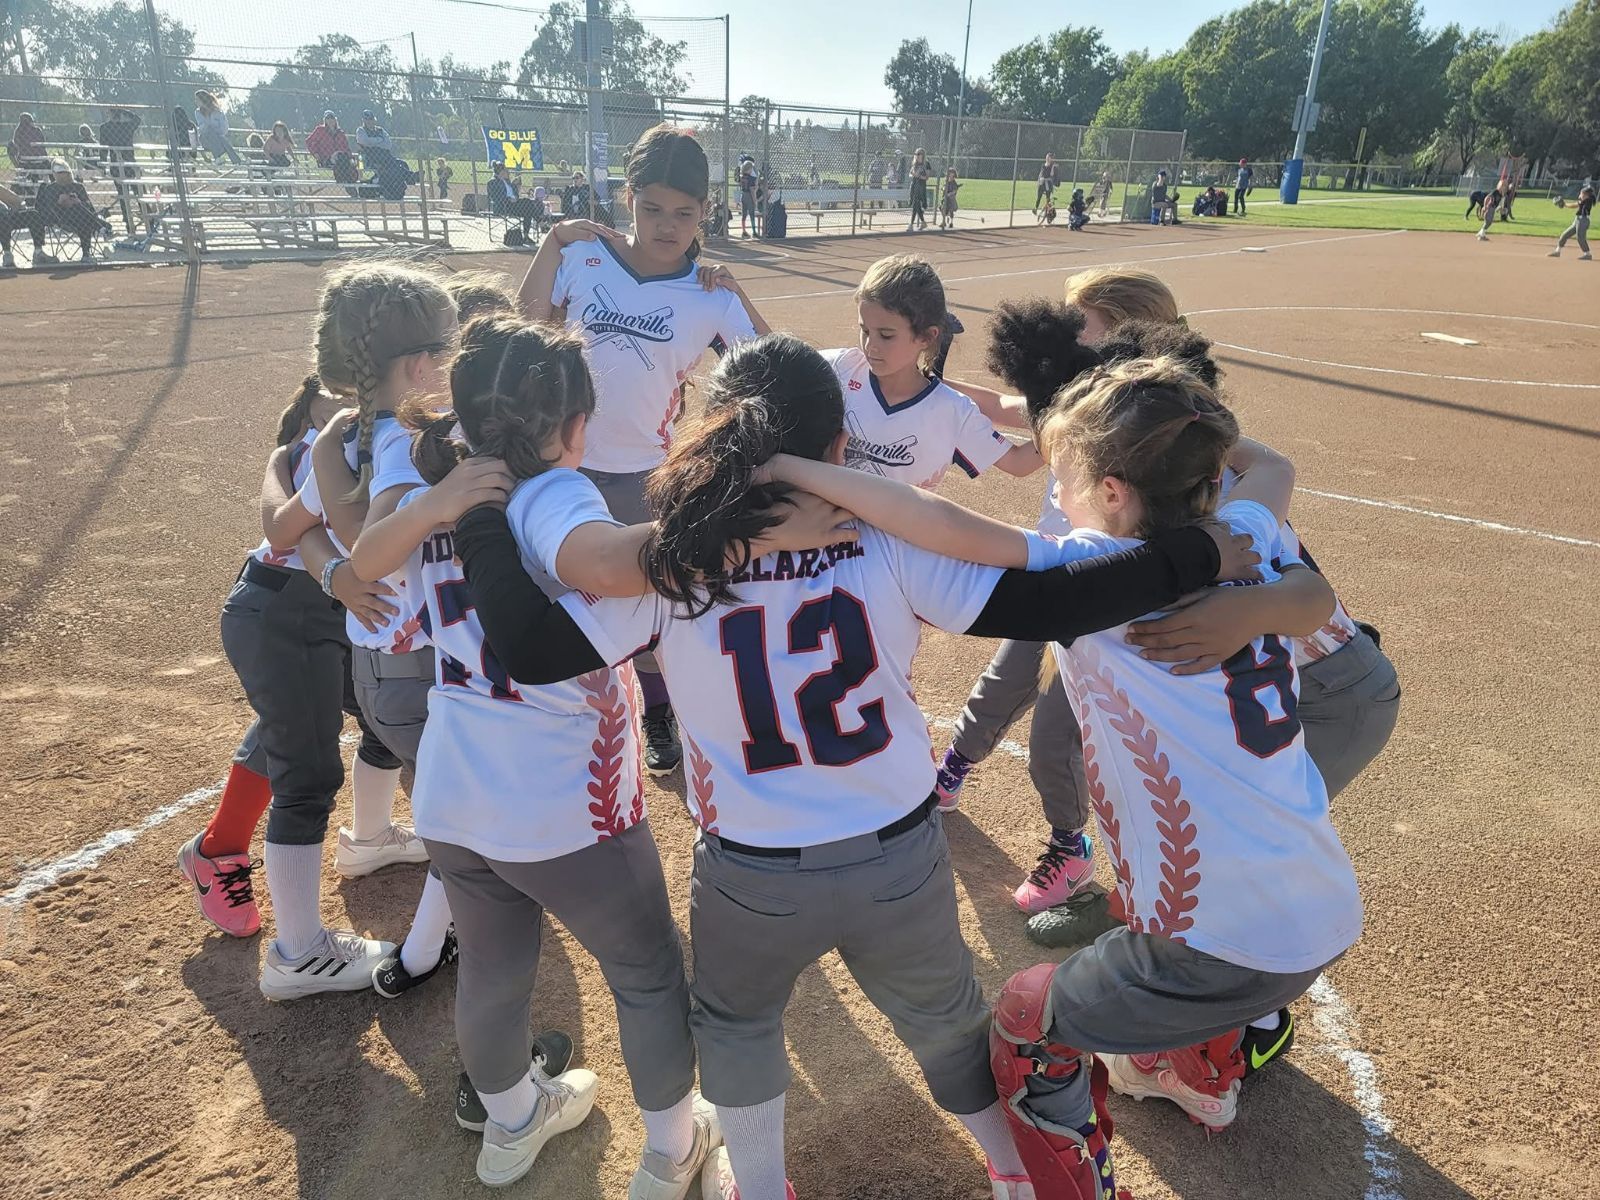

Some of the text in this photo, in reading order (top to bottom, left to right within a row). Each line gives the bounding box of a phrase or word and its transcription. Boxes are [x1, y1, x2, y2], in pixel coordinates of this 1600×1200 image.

[488, 129, 537, 141] GO BLUE
[502, 141, 534, 169] M
[582, 303, 673, 338] Camarillo
[720, 586, 893, 775] 12
[1221, 633, 1302, 759] 8
